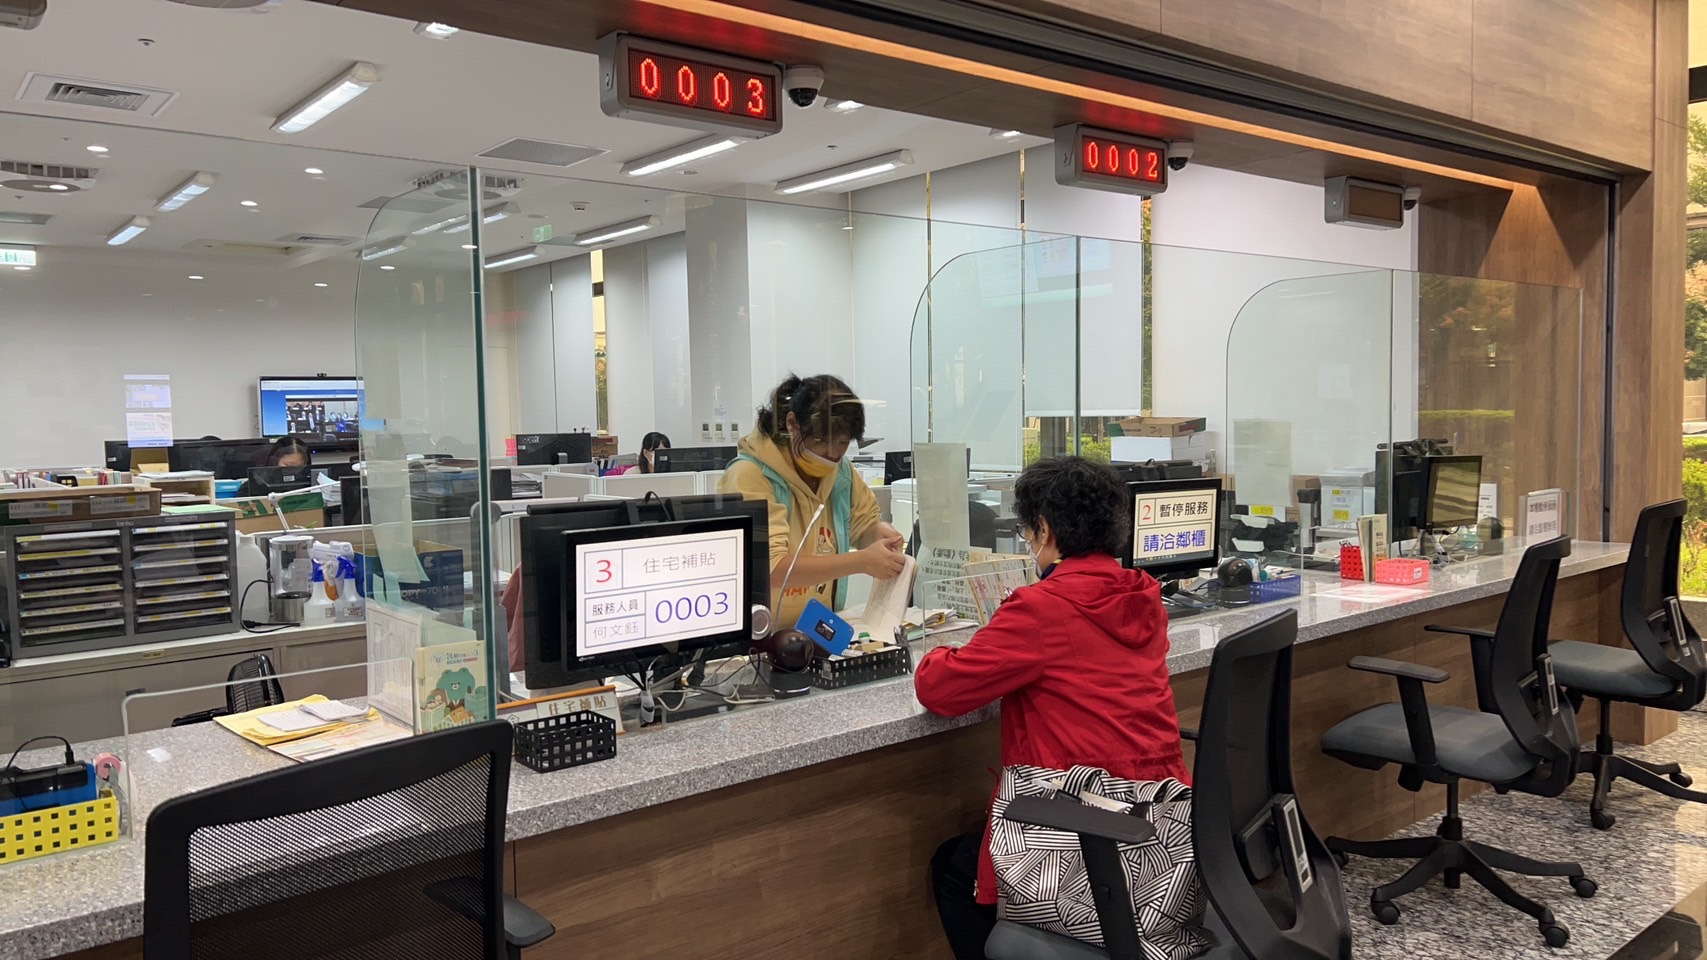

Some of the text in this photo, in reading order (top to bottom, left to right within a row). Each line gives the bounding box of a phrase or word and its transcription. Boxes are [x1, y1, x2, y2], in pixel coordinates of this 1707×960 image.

[639, 57, 764, 114] 0003
[1087, 140, 1159, 179] 0002
[1142, 501, 1209, 520] 2 暫停服務
[1143, 529, 1207, 553] 請洽鄰櫃
[595, 552, 717, 583] 3 住宅補貼
[591, 598, 639, 617] 服務人員
[655, 592, 729, 624] 0003
[592, 620, 640, 640] 何文鈺
[548, 695, 607, 716] 住宅補貼
